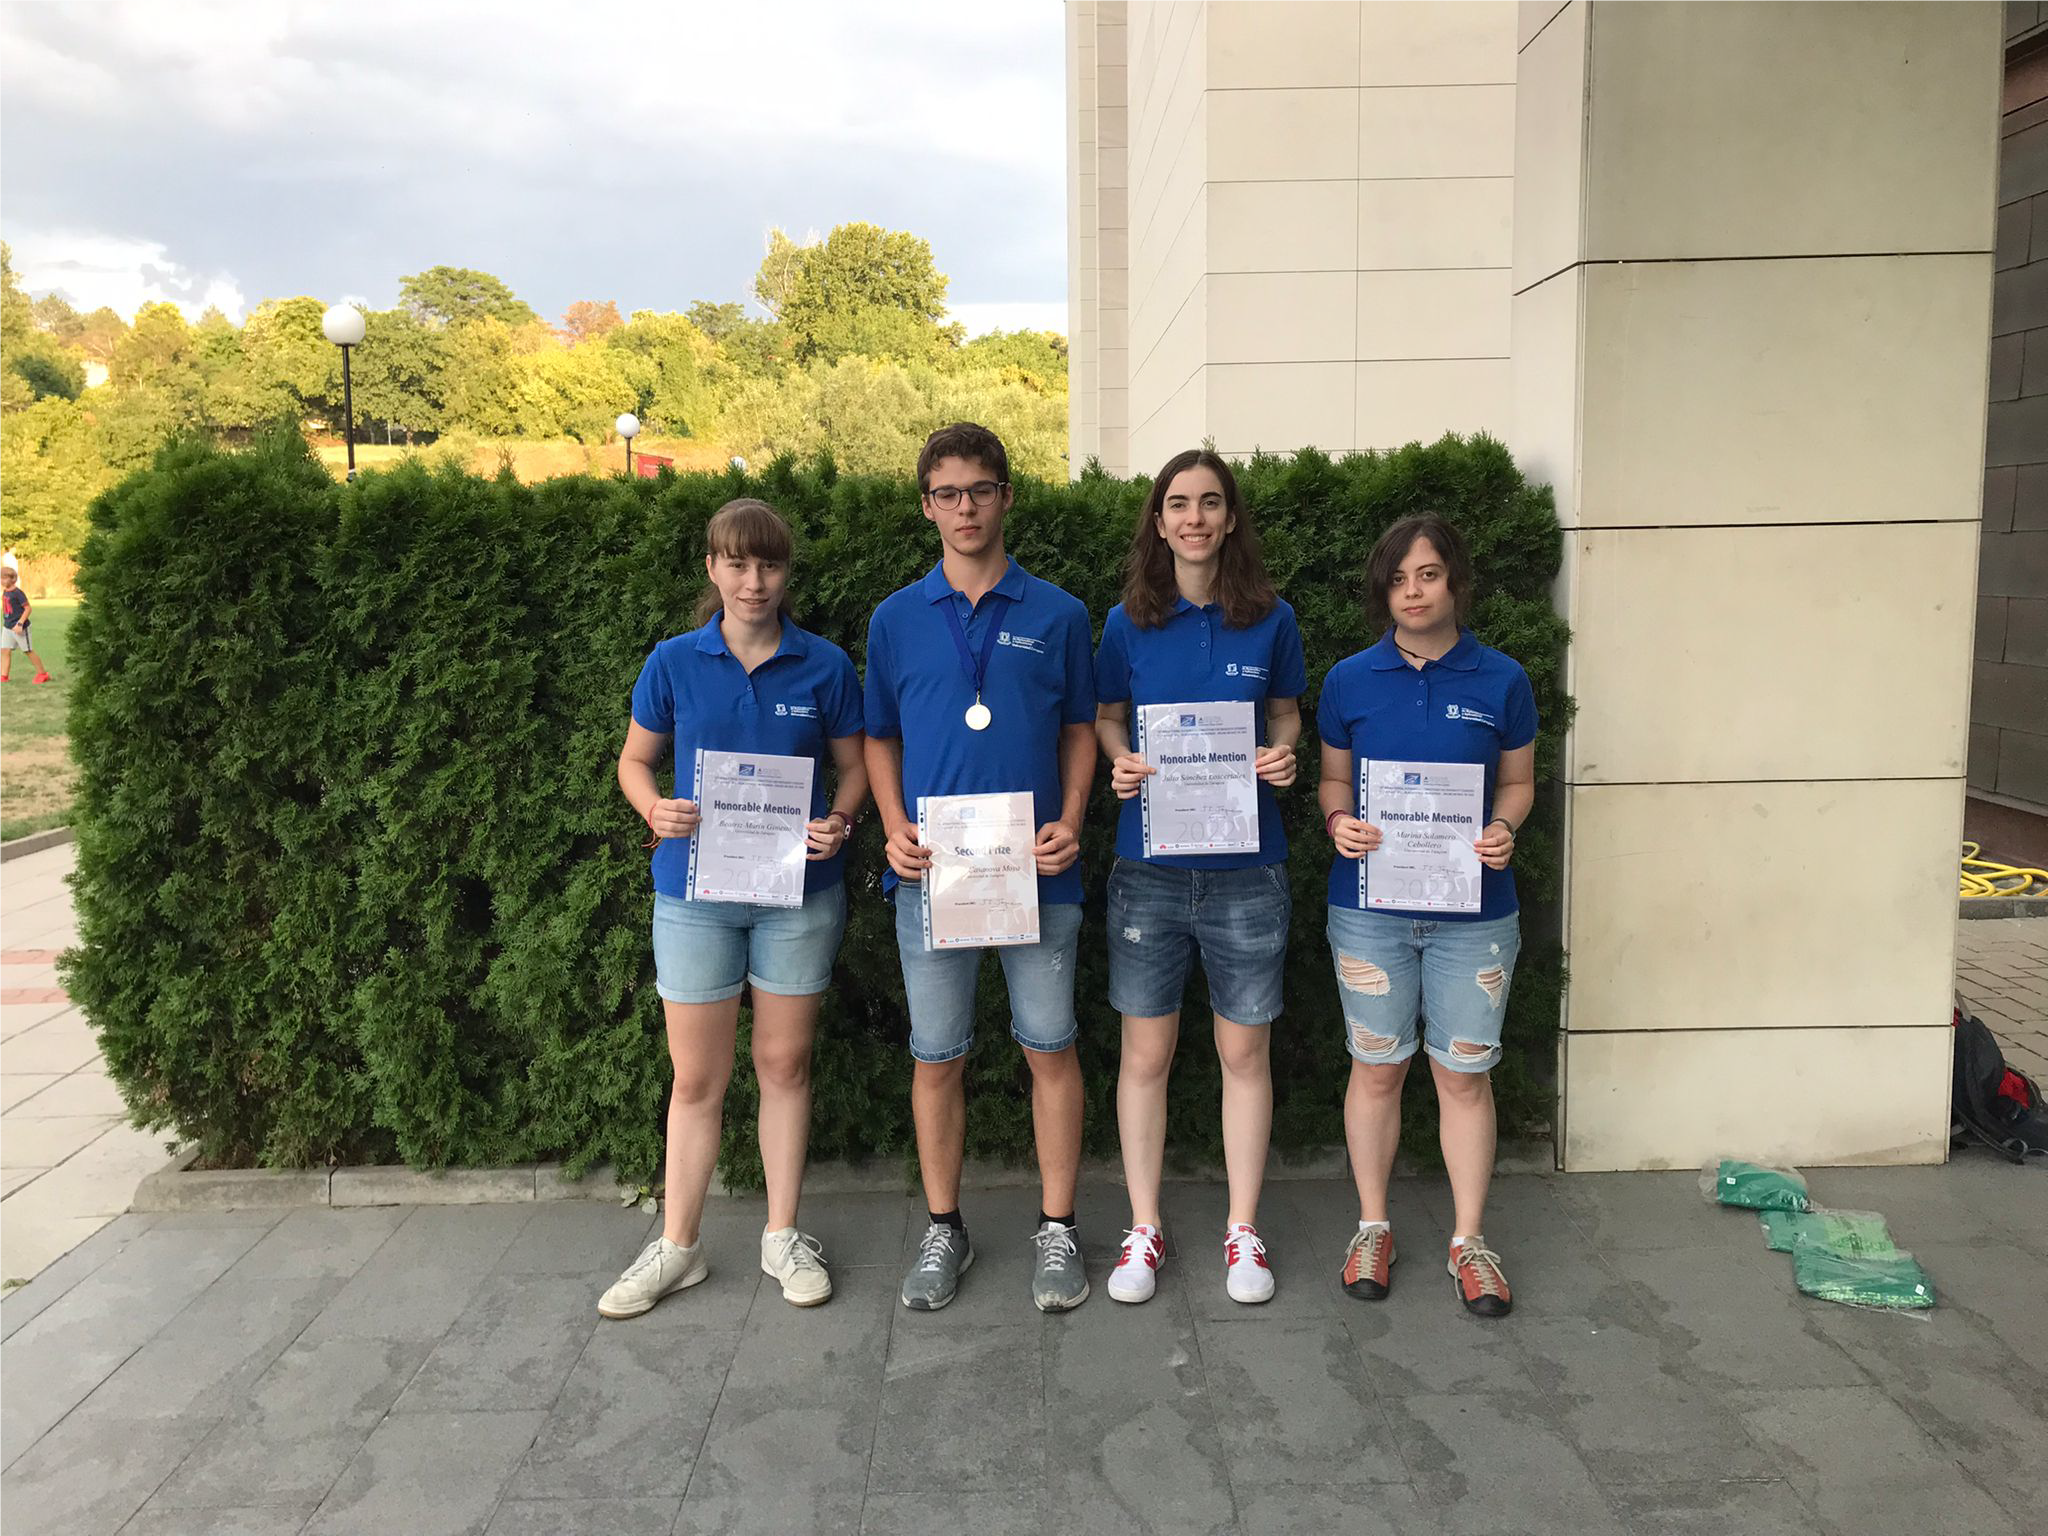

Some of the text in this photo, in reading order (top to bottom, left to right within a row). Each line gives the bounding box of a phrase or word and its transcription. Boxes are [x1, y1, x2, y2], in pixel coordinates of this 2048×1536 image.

[1159, 752, 1247, 764] Honorable Mention
[714, 799, 801, 816] Honorable Mention
[1380, 810, 1473, 824] Honorable Mention
